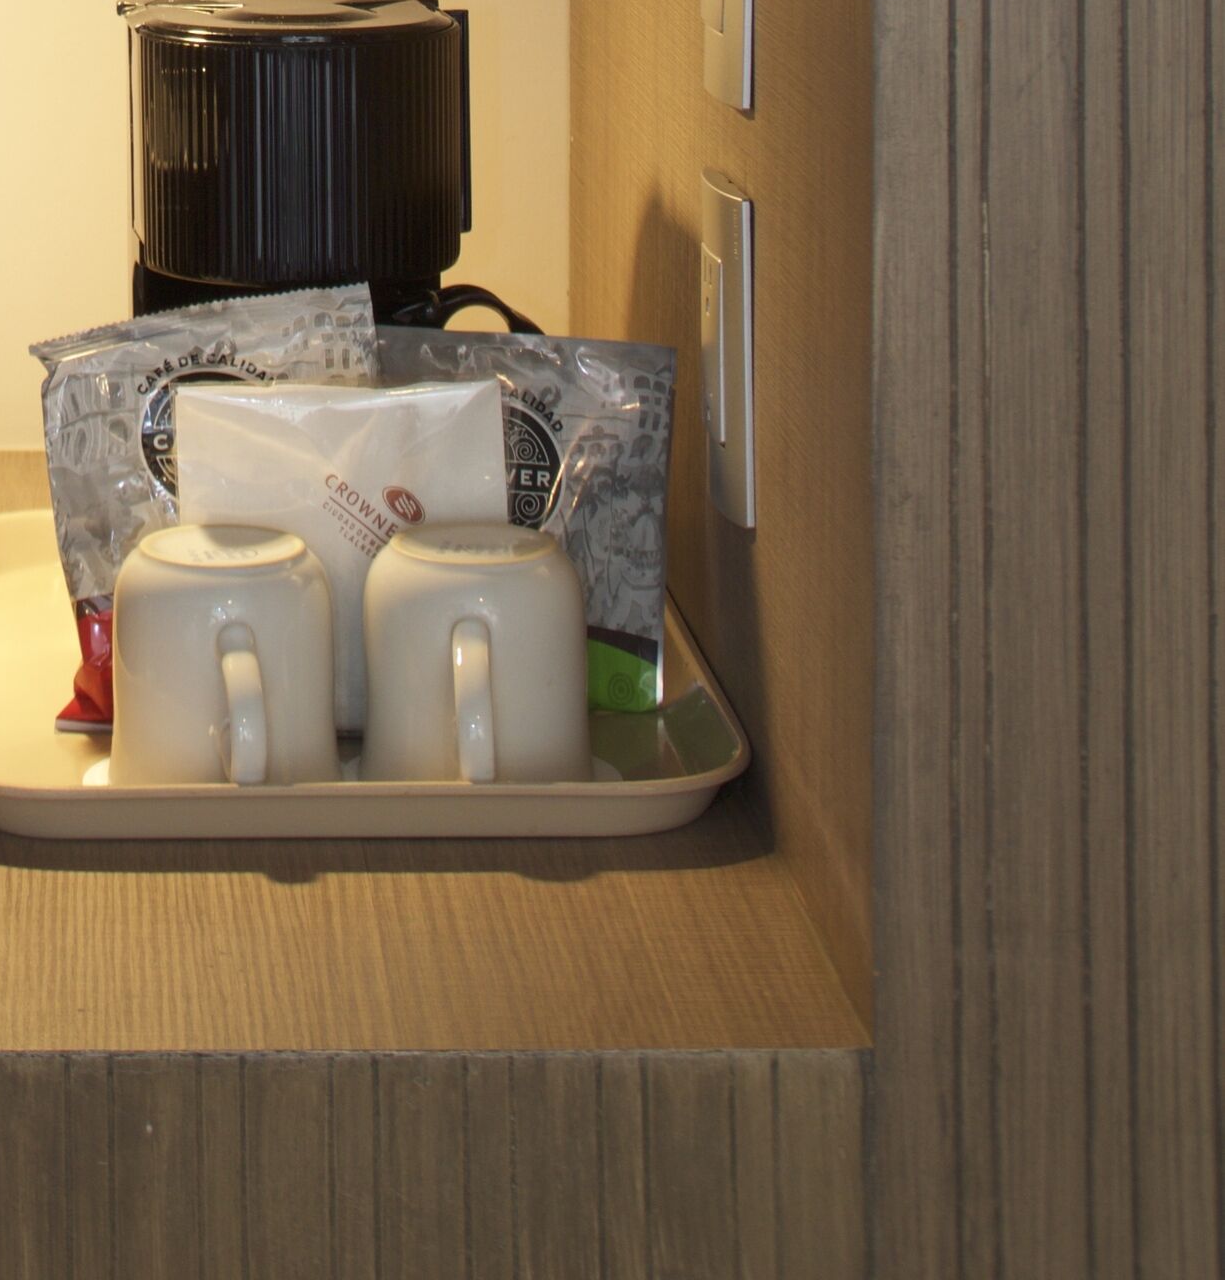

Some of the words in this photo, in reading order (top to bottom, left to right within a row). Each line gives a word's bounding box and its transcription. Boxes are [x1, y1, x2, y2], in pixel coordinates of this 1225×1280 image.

[137, 359, 174, 395] CAFÉ
[178, 352, 200, 368] DE
[508, 388, 563, 433] ALIDAD
[322, 501, 355, 530] CIUDAD
[325, 474, 399, 539] CROWNE
